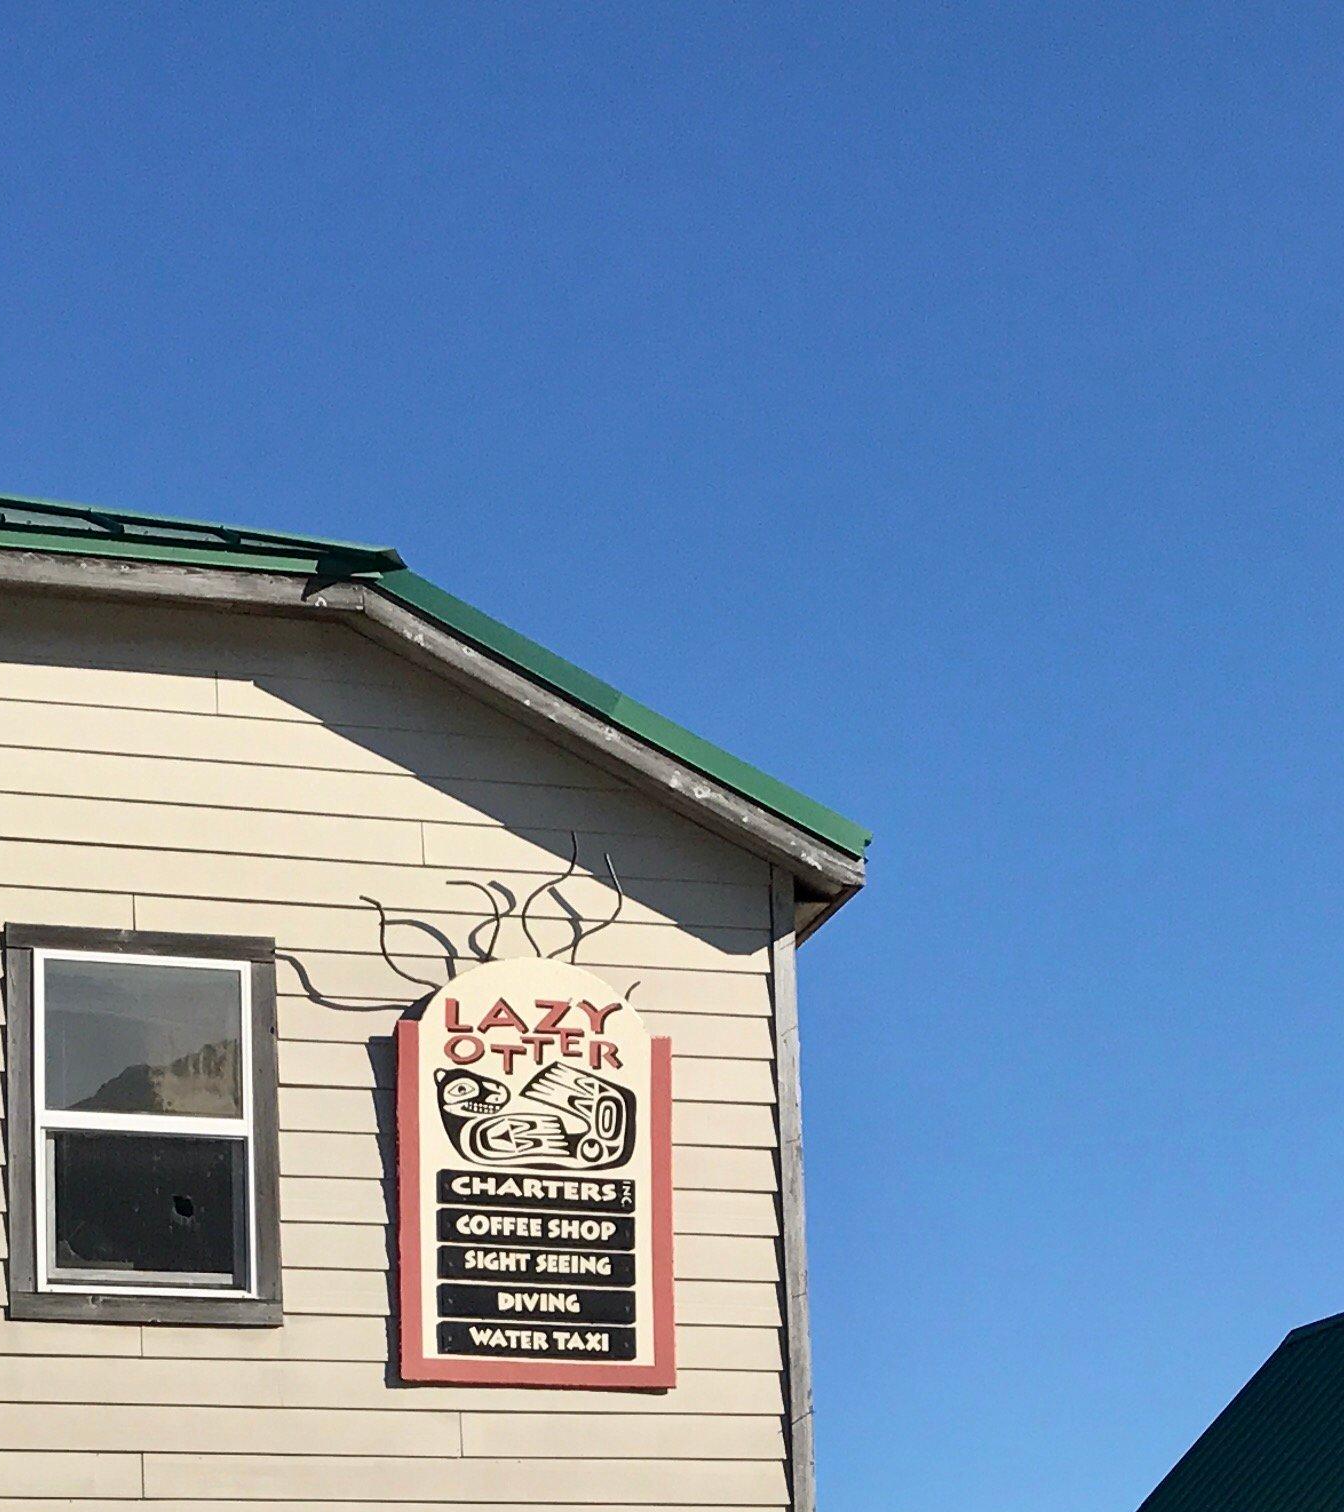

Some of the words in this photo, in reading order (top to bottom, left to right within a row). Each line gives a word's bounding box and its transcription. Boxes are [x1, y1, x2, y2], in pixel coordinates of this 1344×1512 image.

[444, 997, 623, 1035] LAZY
[443, 1027, 624, 1075] OTTER
[451, 1176, 617, 1202] CHARTERS
[455, 1213, 542, 1238] COFFEE
[547, 1217, 617, 1241] SHOP
[464, 1245, 531, 1272] SIGHT
[536, 1250, 613, 1277] SEEING
[497, 1291, 581, 1315] DIVING
[468, 1326, 549, 1352] WATER
[553, 1331, 610, 1352] TAXI
